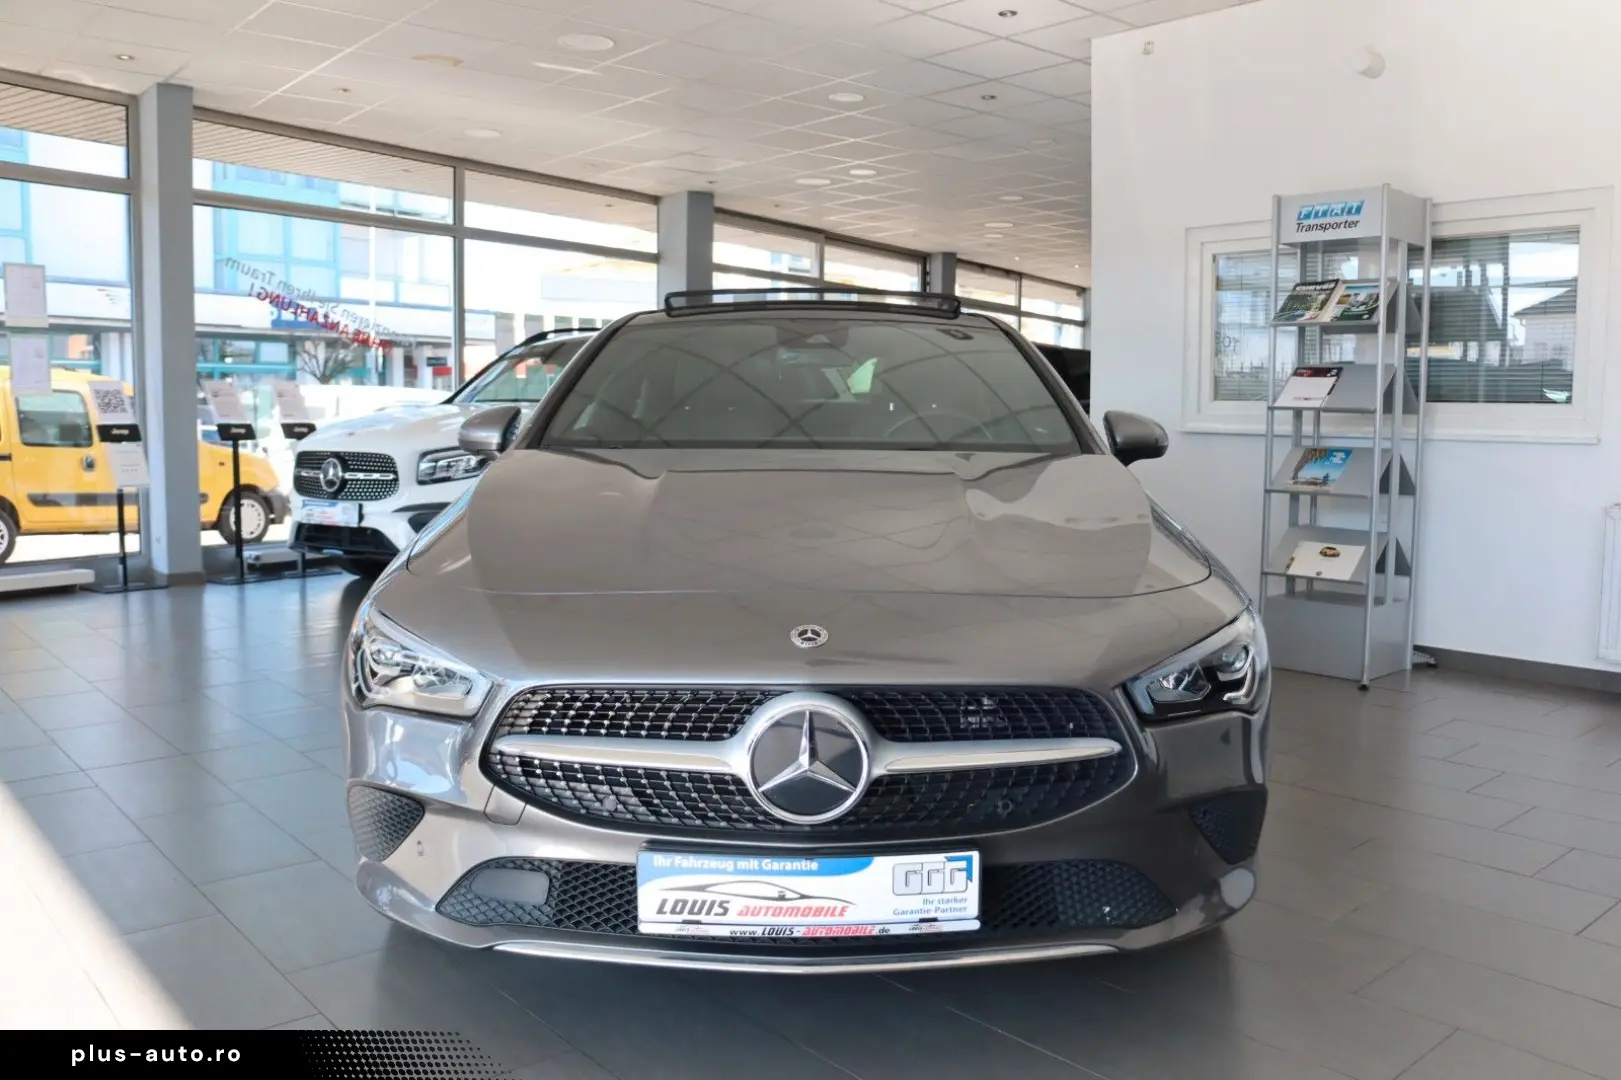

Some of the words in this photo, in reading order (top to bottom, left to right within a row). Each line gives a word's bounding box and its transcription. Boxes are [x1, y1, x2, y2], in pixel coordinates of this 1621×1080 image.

[1296, 220, 1360, 232] Transporter
[653, 855, 672, 868] Ihr
[674, 855, 735, 872] Fahrzeug
[737, 858, 759, 870] mit
[762, 859, 819, 871] Garantie
[922, 897, 935, 906] Ihr
[937, 896, 968, 905] starker
[655, 898, 731, 917] LOUIS
[892, 906, 968, 916] Garantie-Partner
